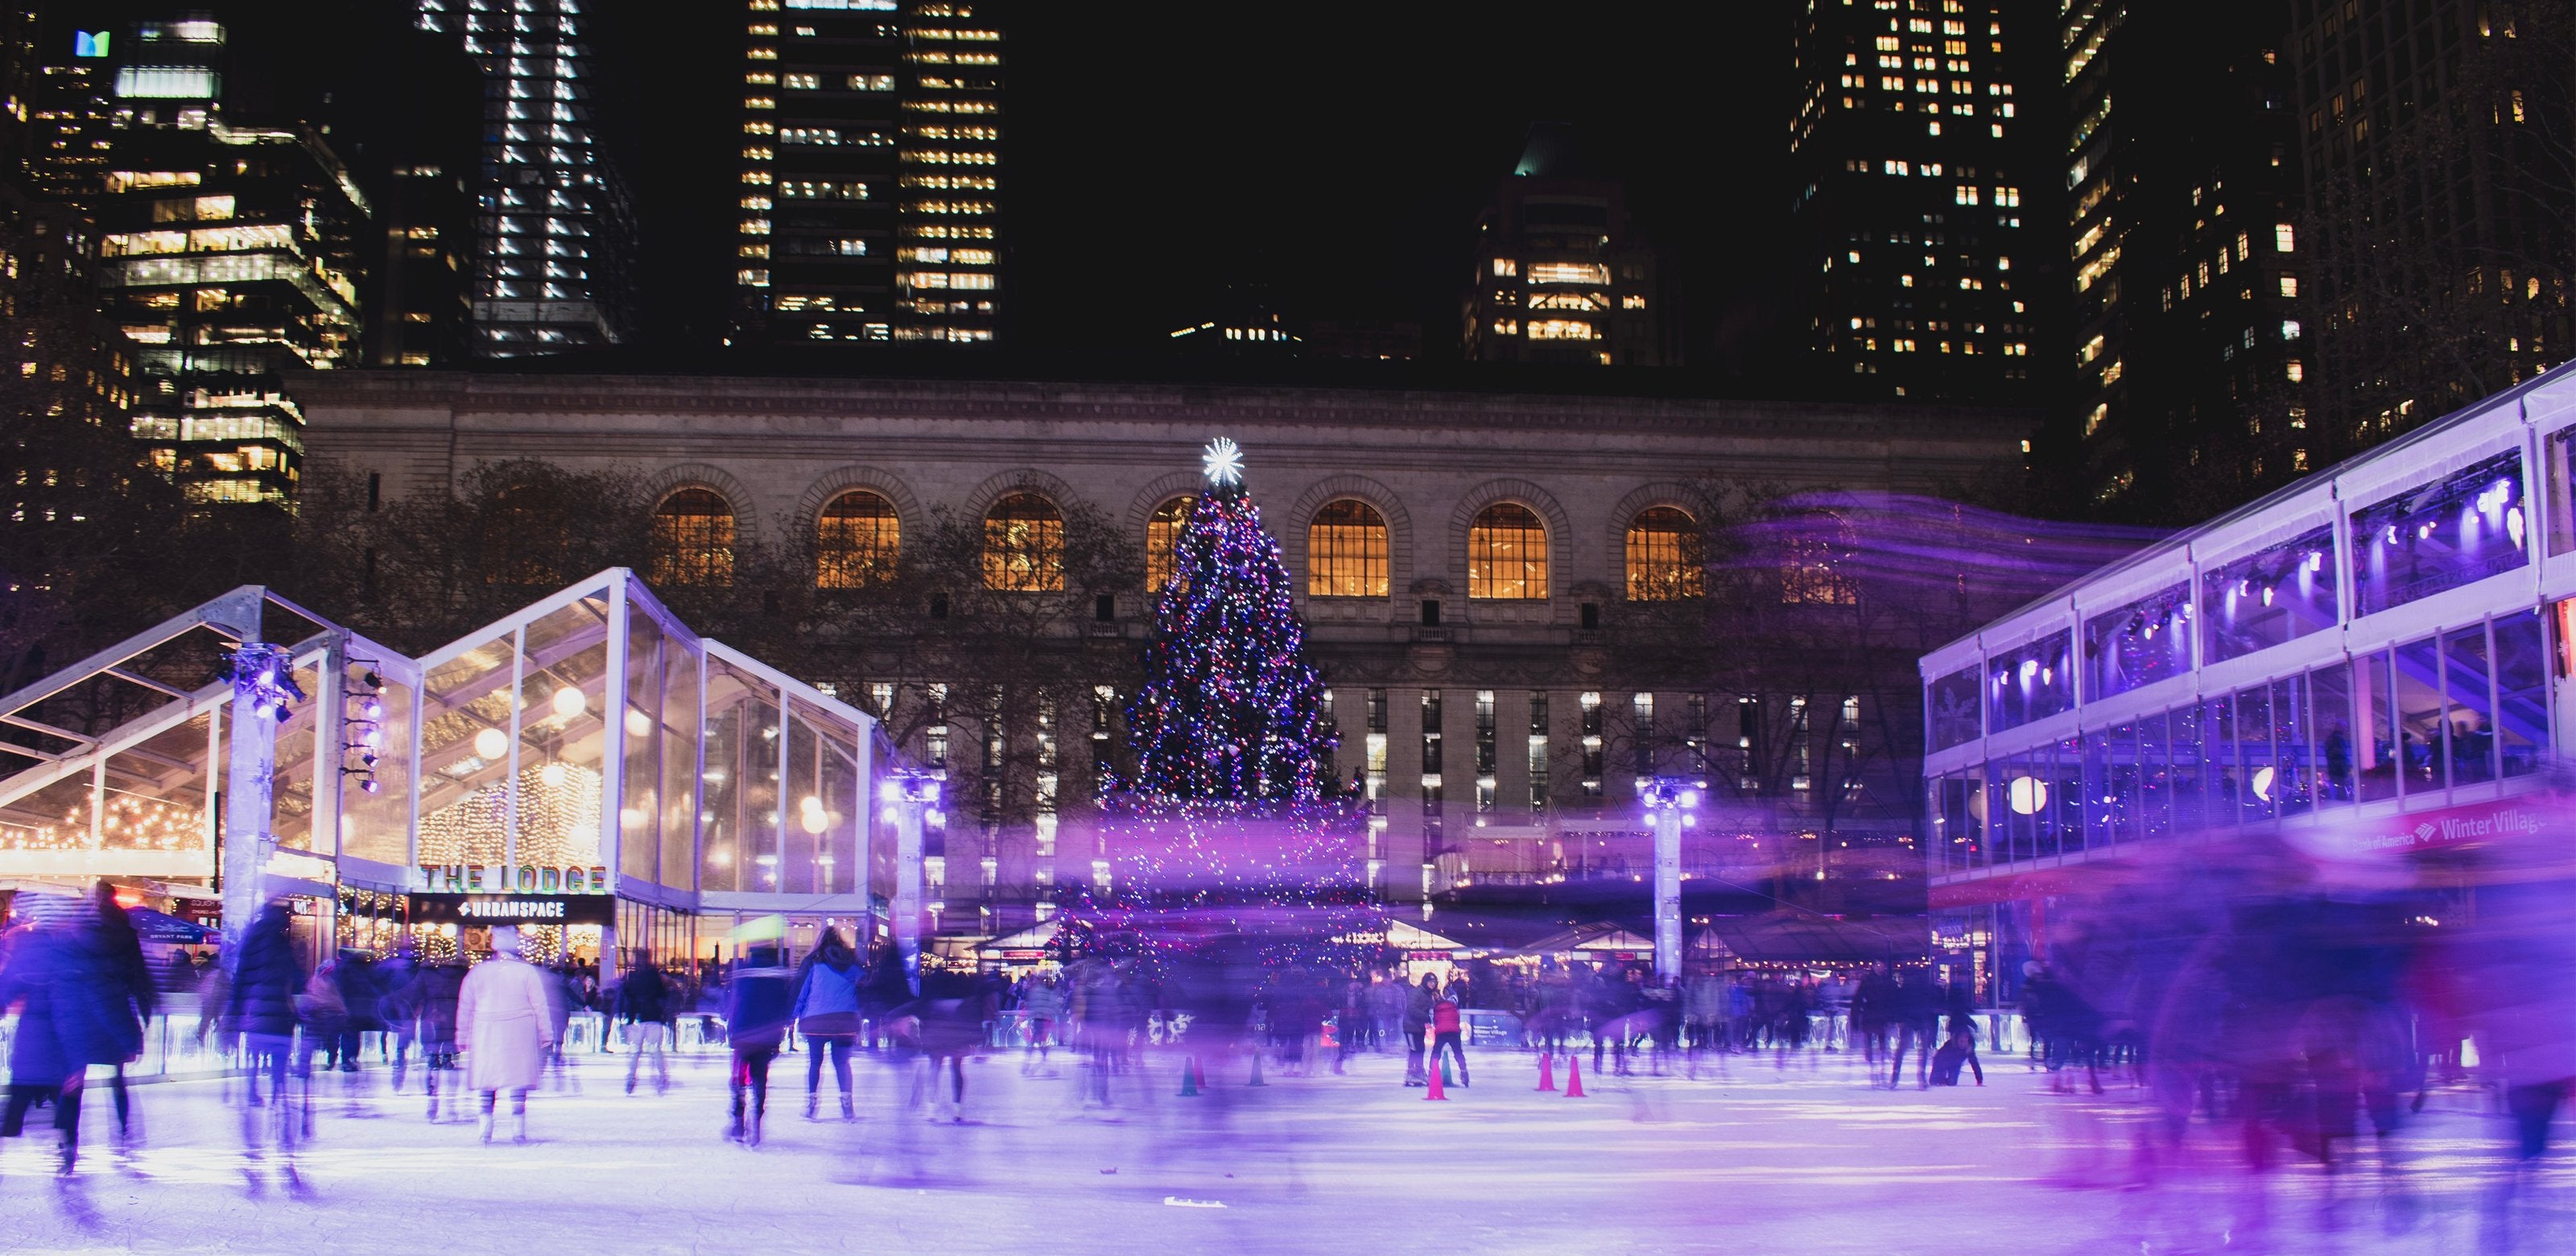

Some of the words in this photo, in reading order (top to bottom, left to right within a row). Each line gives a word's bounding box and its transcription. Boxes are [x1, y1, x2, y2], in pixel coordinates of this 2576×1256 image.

[2382, 833, 2415, 849] America
[2441, 817, 2491, 841] Winter
[421, 865, 484, 894] THE
[501, 866, 606, 894] LODGE
[471, 901, 564, 917] URBANSPACE
